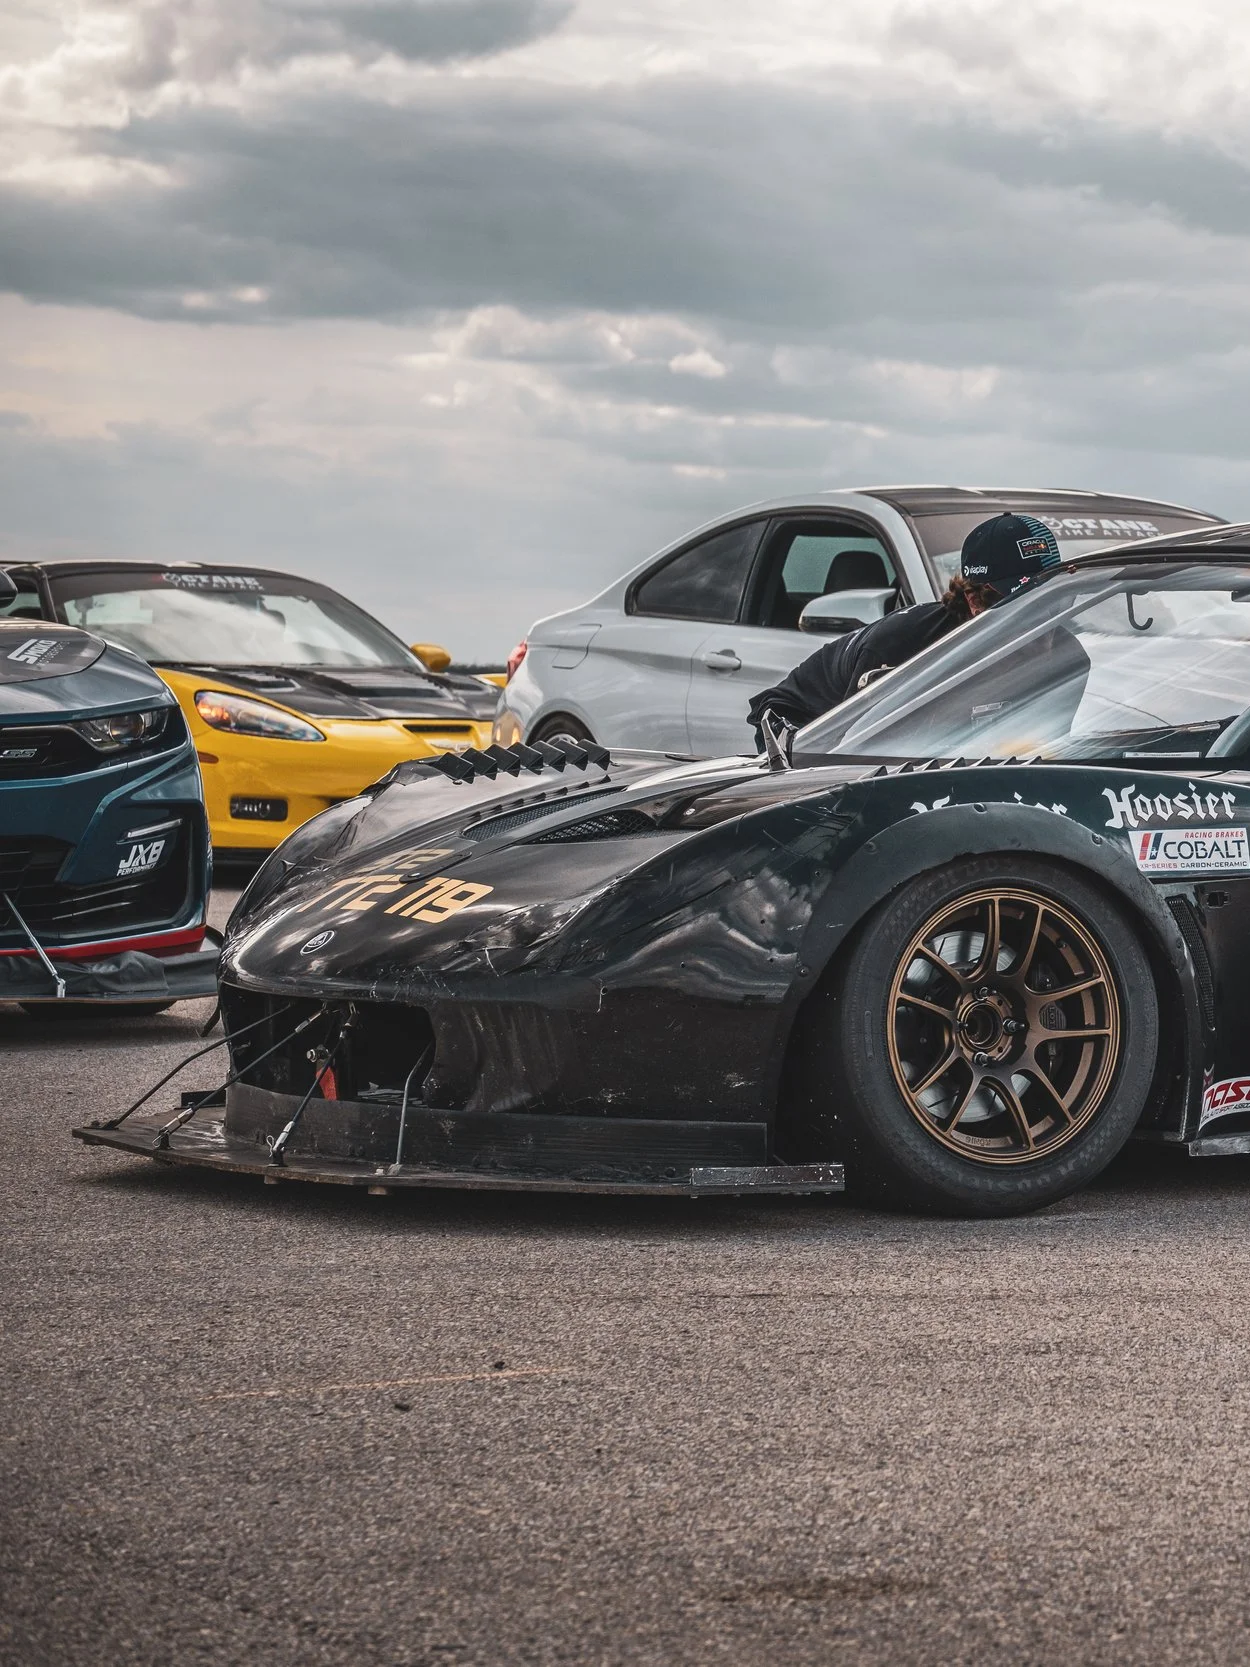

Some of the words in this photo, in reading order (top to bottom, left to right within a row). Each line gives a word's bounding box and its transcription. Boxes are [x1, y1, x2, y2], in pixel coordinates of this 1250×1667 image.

[1102, 783, 1236, 829] Hoosier
[1163, 839, 1246, 860] COBALT
[1180, 860, 1248, 868] CARBON-CERAMIC
[383, 876, 494, 924] 119
